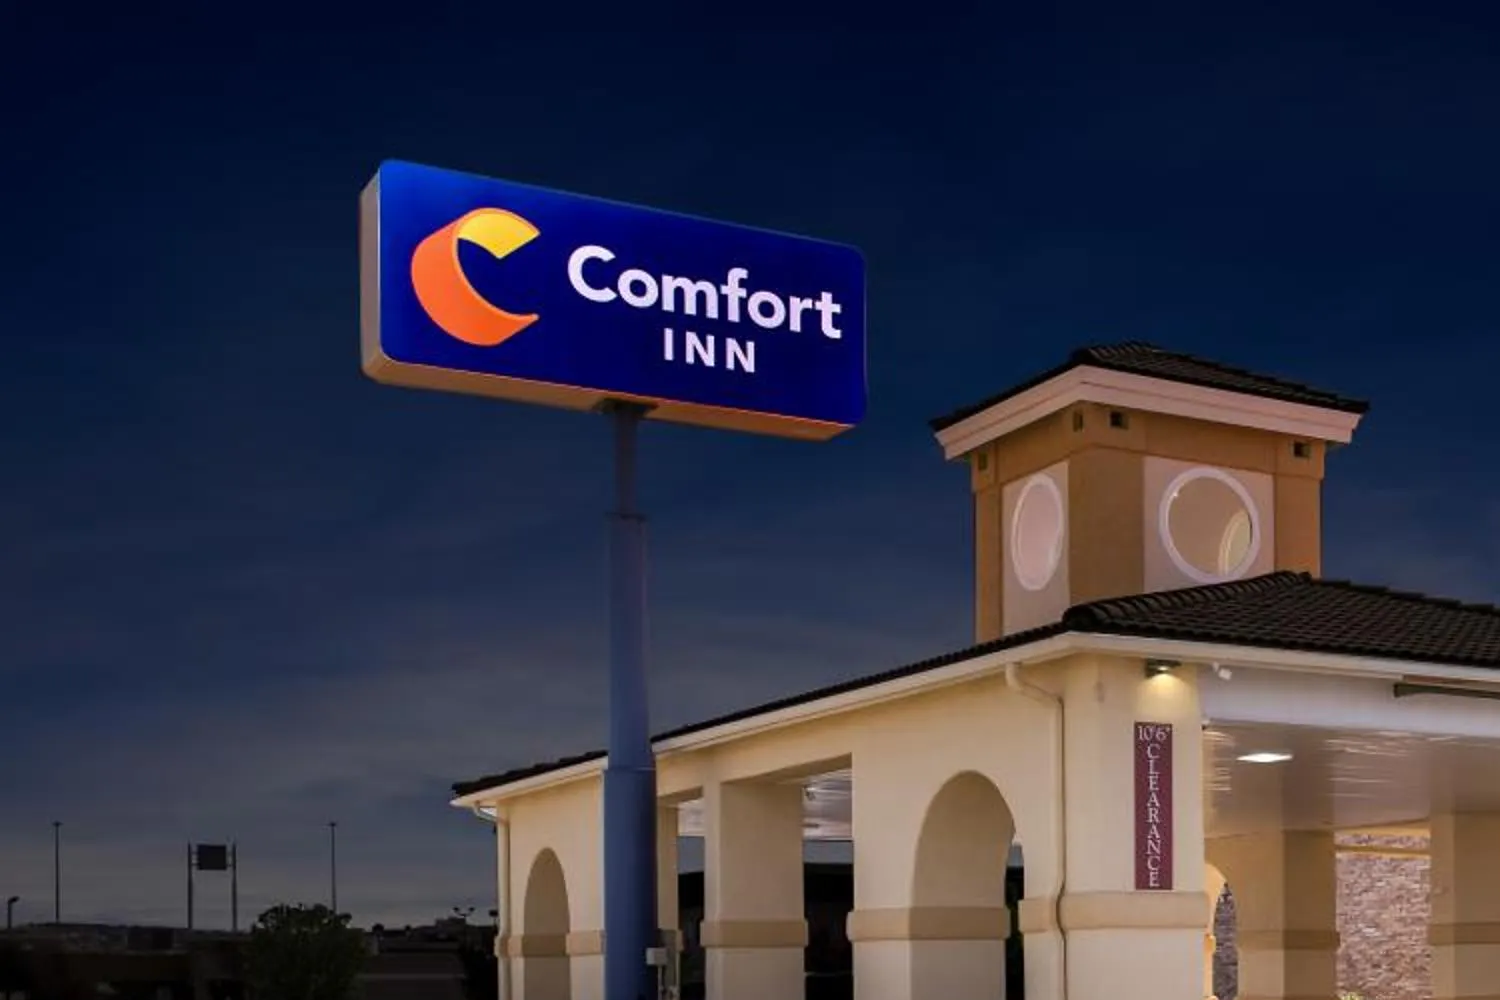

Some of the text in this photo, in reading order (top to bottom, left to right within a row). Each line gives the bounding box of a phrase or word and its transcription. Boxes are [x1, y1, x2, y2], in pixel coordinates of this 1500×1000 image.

[567, 244, 842, 339] Comfort
[664, 327, 756, 374] INN
[1146, 743, 1161, 888] CLEARANCE
